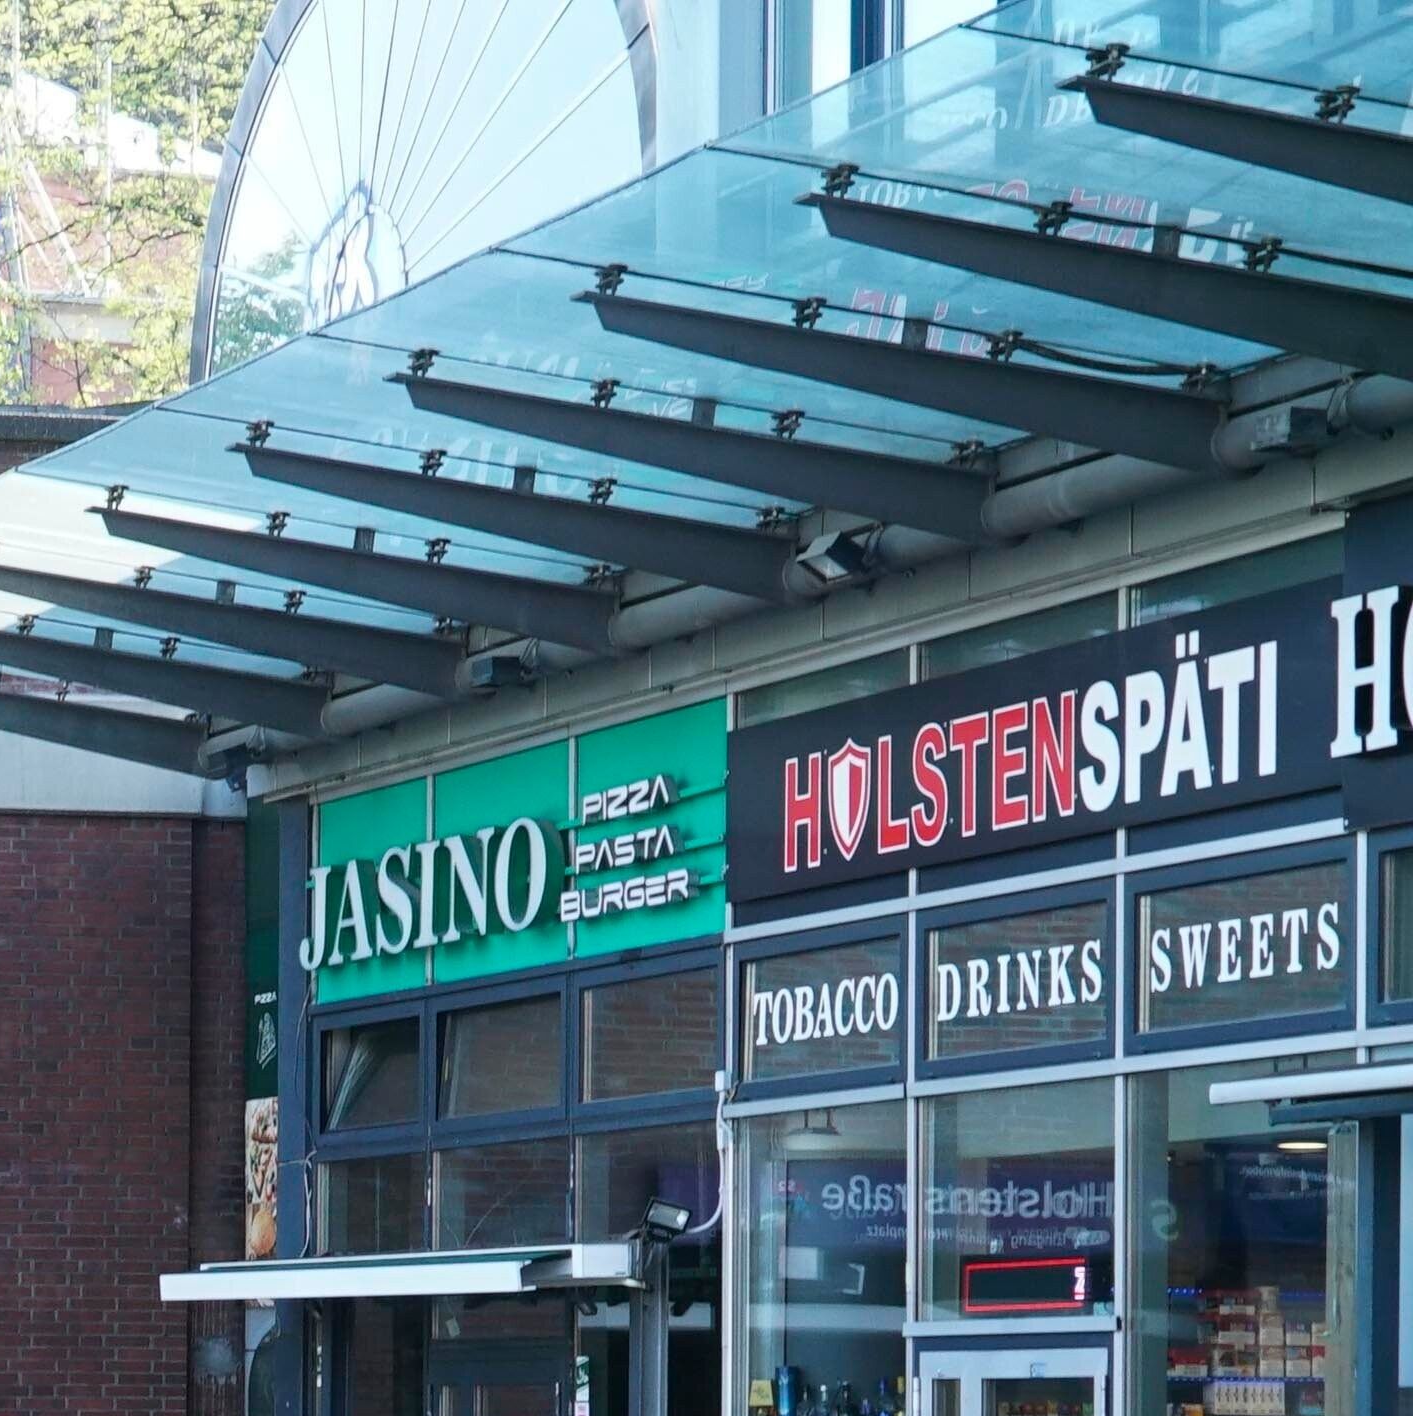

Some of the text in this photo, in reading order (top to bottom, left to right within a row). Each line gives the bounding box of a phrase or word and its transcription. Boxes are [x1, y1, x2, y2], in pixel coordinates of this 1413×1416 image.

[582, 774, 671, 826] PIZZA
[574, 824, 676, 874] PASTA
[299, 818, 549, 972] JASINO
[560, 869, 690, 923] BURGER
[752, 903, 1340, 1046] TOBACCO DRINKS SWEETS
